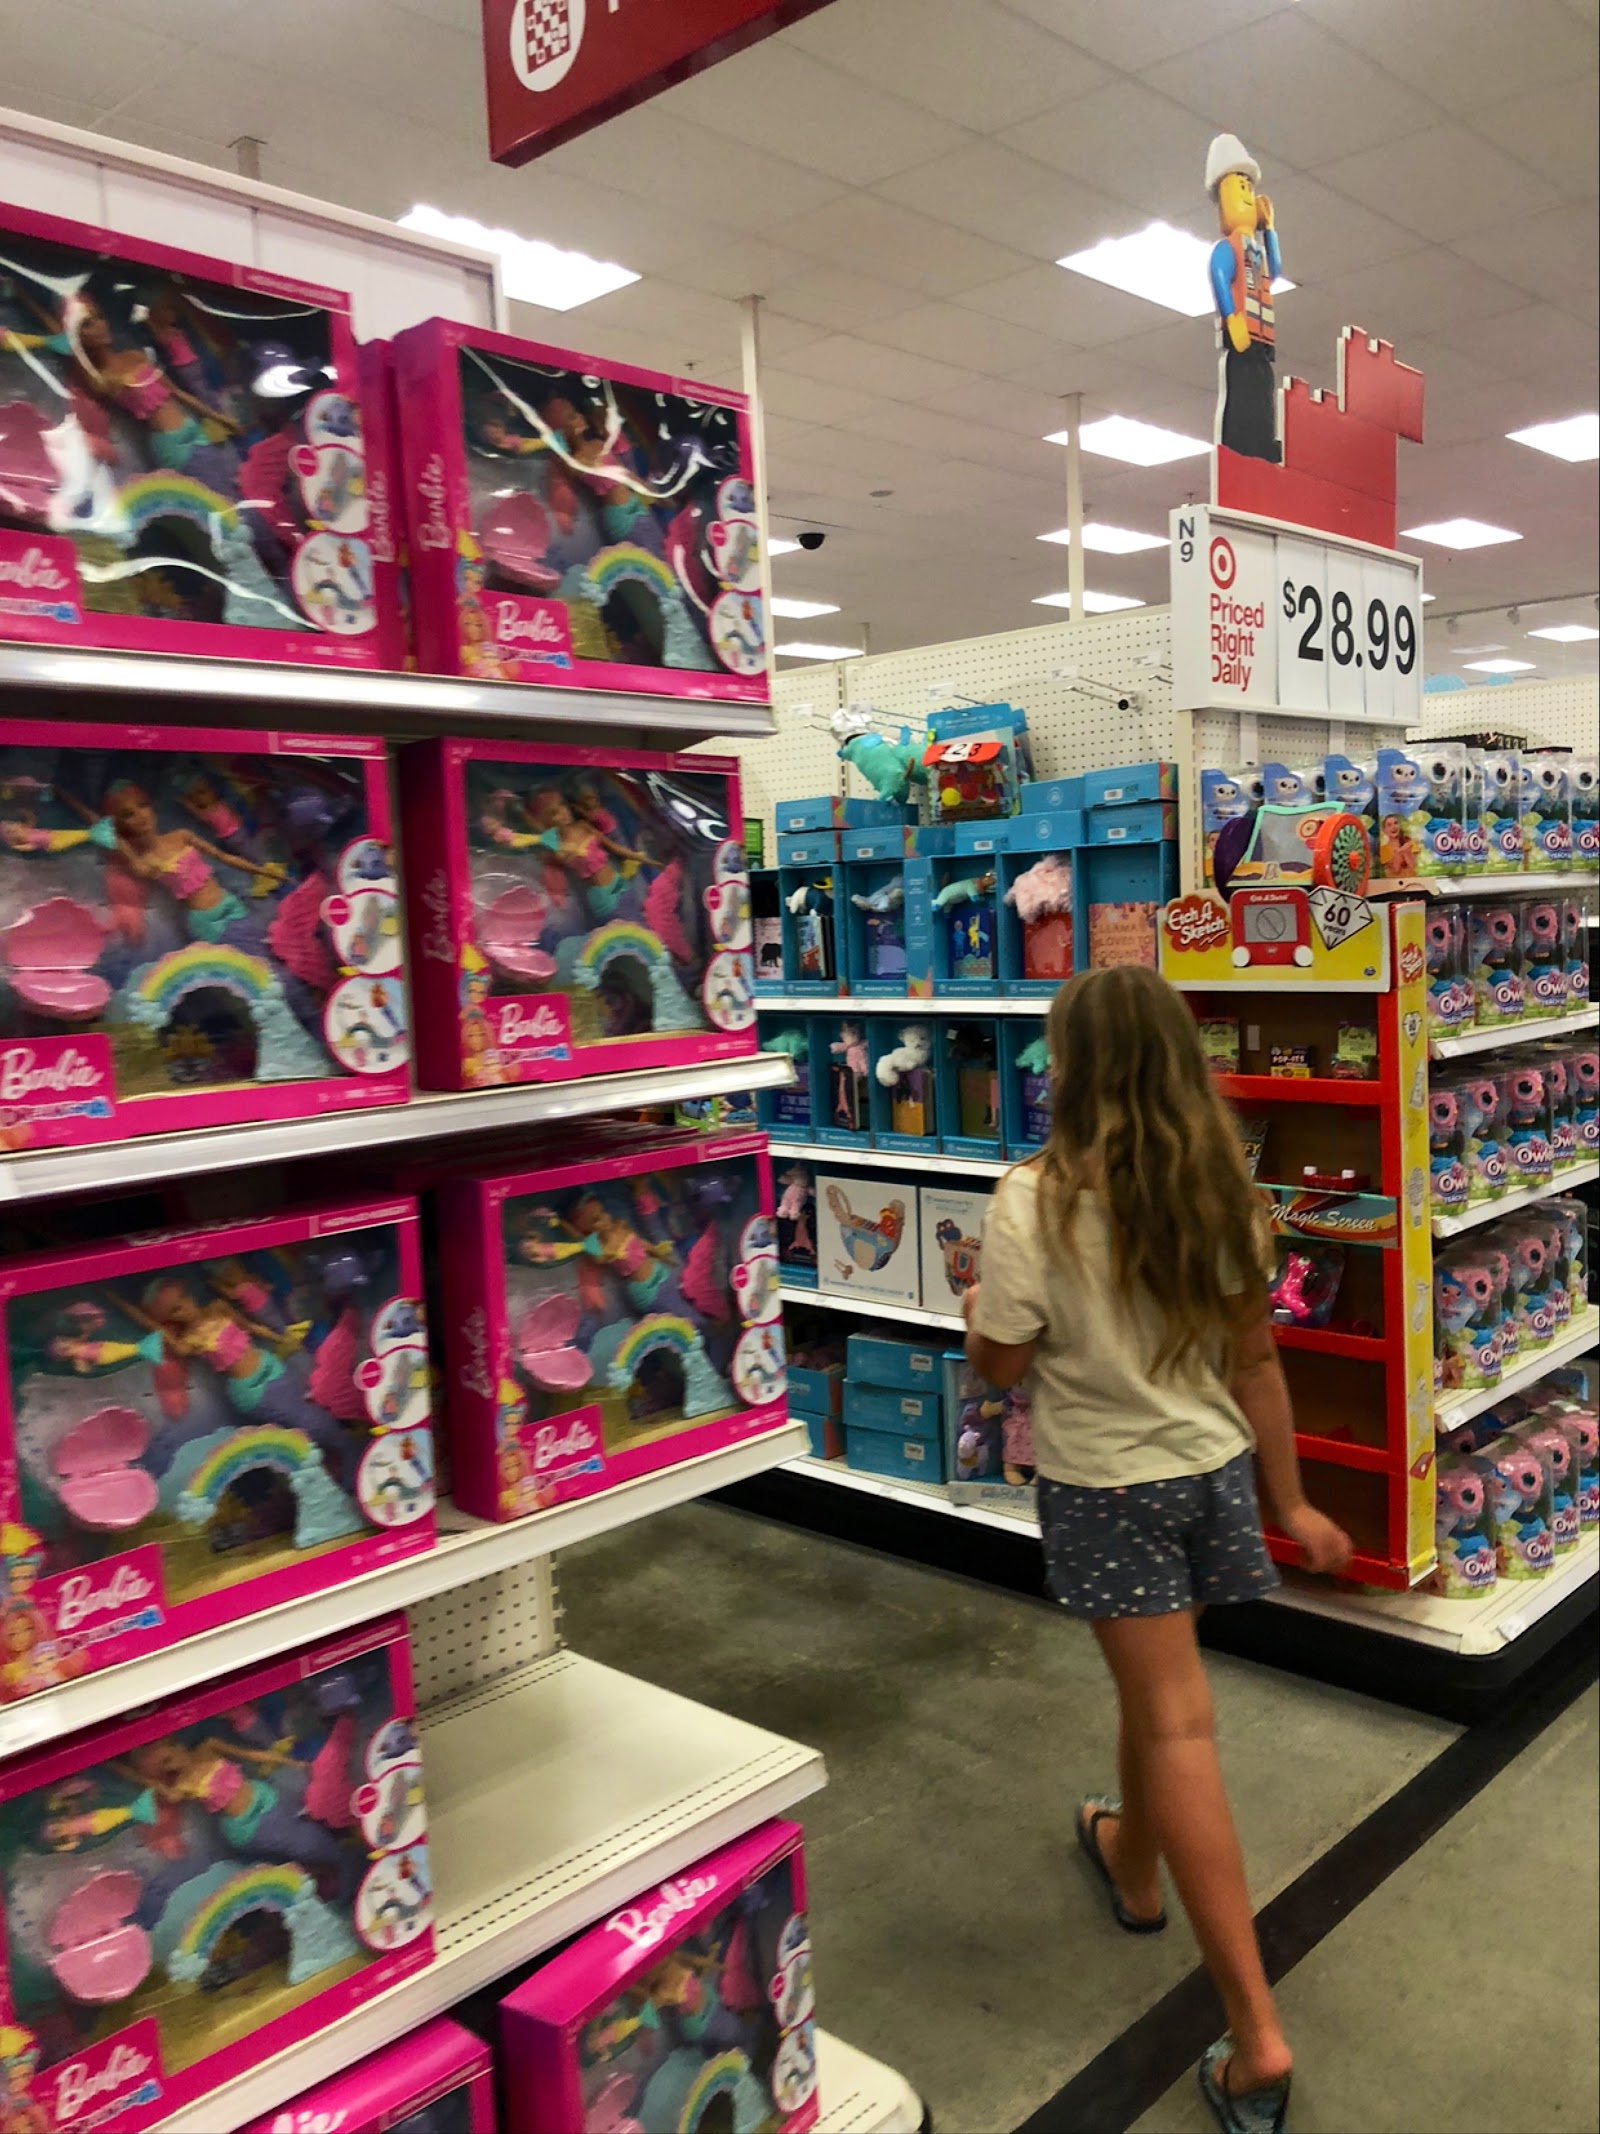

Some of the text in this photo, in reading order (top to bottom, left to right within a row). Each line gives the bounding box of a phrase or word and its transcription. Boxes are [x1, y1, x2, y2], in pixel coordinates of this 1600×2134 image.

[1178, 517, 1195, 539] N
[1180, 542, 1194, 562] 9
[496, 600, 566, 642] Barbie
[1210, 593, 1264, 628] Priced
[1283, 577, 1416, 675] $28.99
[1211, 624, 1255, 661] Right
[1212, 655, 1252, 692] Daily
[1168, 901, 1213, 930] Etch A
[1180, 919, 1226, 944] Sketch
[1323, 903, 1351, 927] 60
[1323, 922, 1346, 936] years
[499, 1003, 566, 1045] Barbie
[0, 1047, 105, 1100] Barbie
[1270, 1203, 1377, 1231] Magic Screen
[533, 1420, 598, 1469] Barbie
[56, 1565, 155, 1631] Barbie
[606, 1875, 718, 1948] Barbie
[54, 2044, 153, 2121] Barbie
